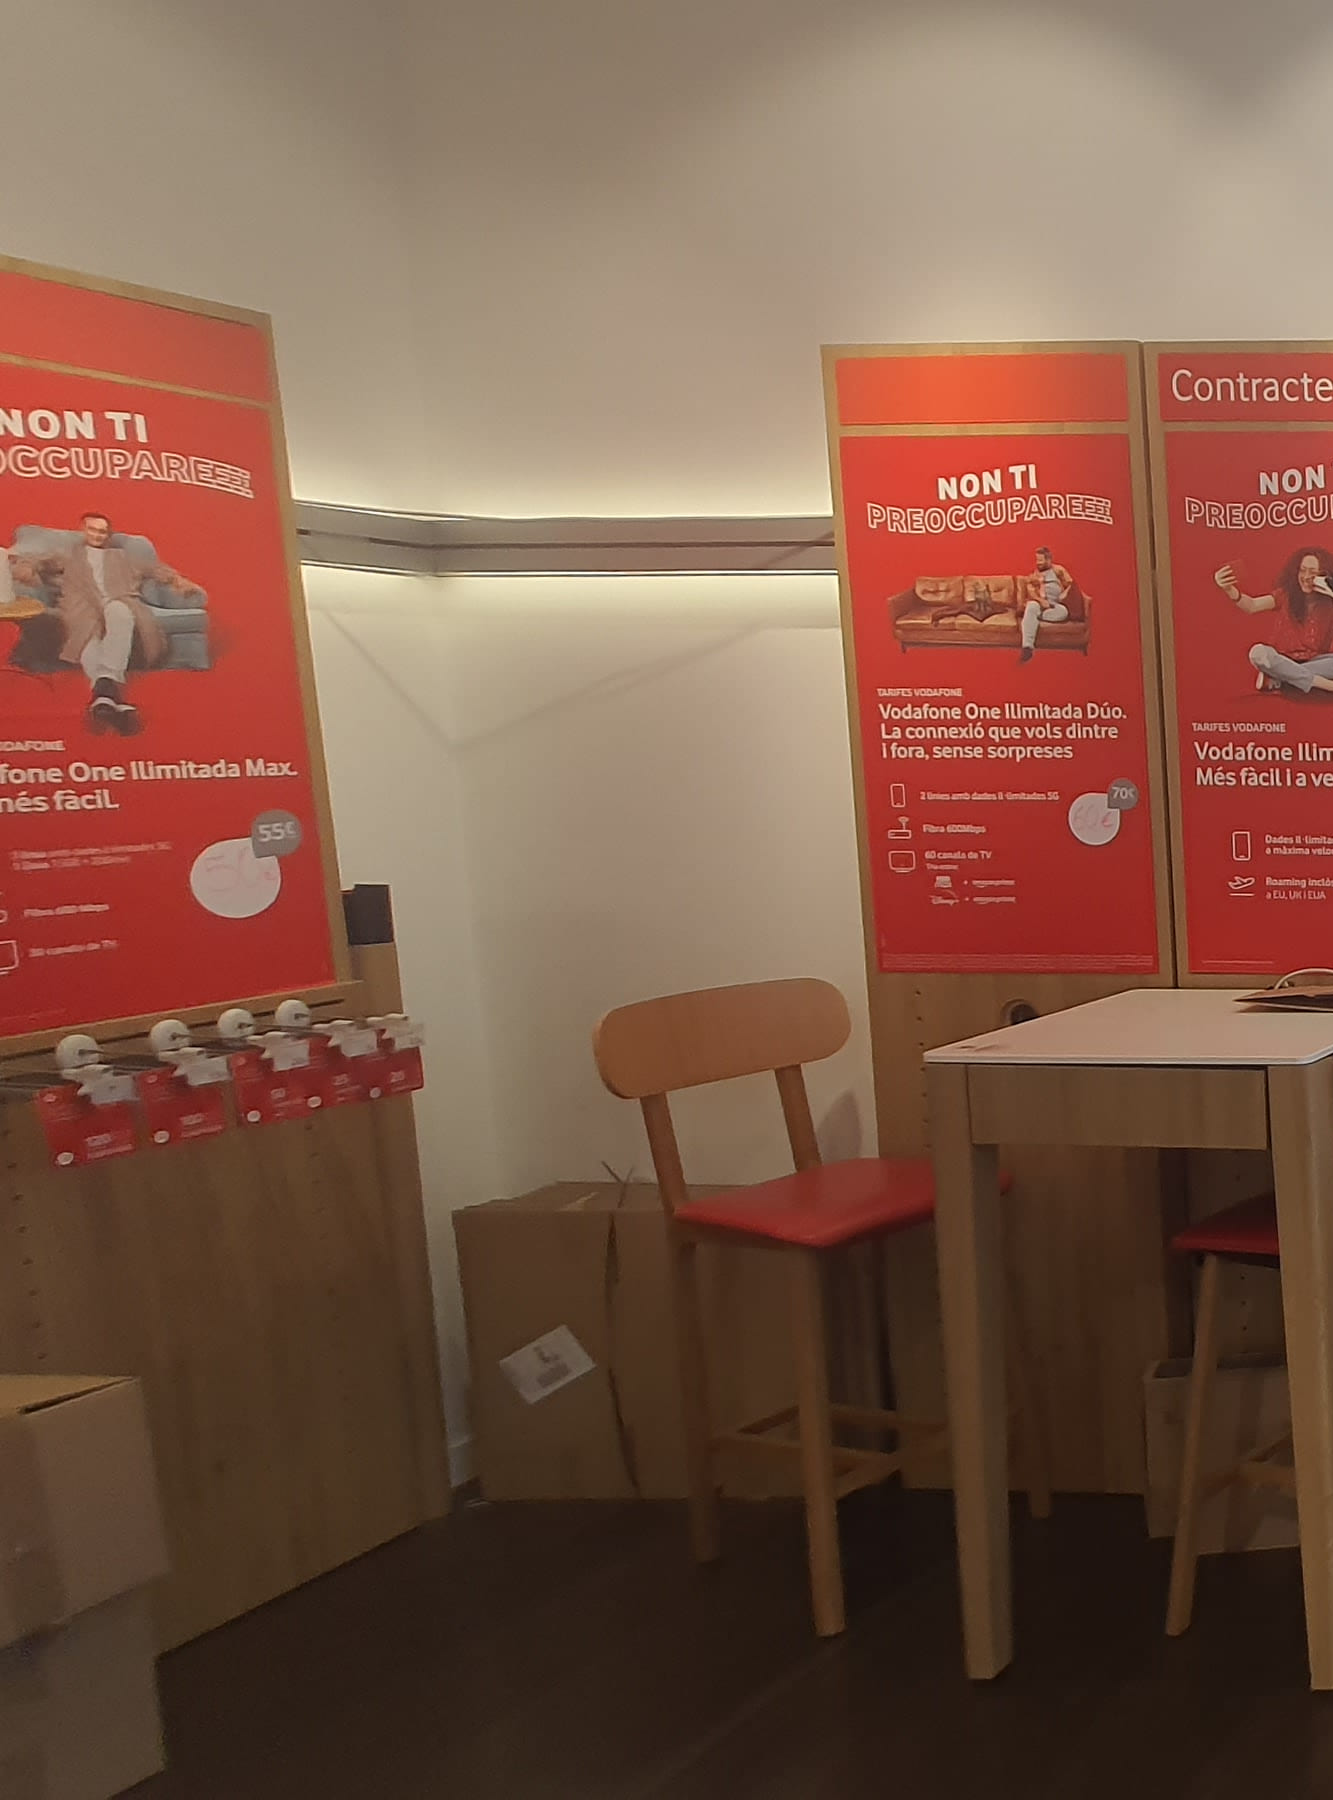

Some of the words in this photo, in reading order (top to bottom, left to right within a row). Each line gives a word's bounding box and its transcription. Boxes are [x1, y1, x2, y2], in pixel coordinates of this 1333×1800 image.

[1171, 368, 1333, 403] Contracte
[105, 411, 149, 443] TI
[937, 467, 1003, 501] NON
[1008, 463, 1037, 490] TI
[1259, 463, 1326, 496] NON
[877, 687, 913, 698] TARIFES
[914, 688, 963, 698] VODAFONE
[878, 702, 962, 720] Vodafone
[965, 703, 1001, 720] One
[1005, 702, 1083, 720] Ilimitada
[1087, 701, 1128, 720] Dúo.
[881, 723, 902, 740] La
[905, 722, 985, 740] connexió
[988, 726, 1022, 743] que
[1024, 722, 1062, 740] vols
[1065, 722, 1119, 740] dintre
[1192, 722, 1231, 733] TARIFES
[1232, 723, 1287, 733] VODAFONE
[890, 742, 930, 761] fora,
[932, 746, 984, 760] sense
[987, 746, 1074, 762] sorpreses
[1194, 741, 1293, 762] Vodafone
[68, 761, 127, 783] One
[130, 758, 241, 781] Ilimitada
[245, 758, 299, 778] Max.
[1195, 766, 1237, 786] Més
[1239, 766, 1282, 787] fàcil
[1286, 769, 1291, 787] i
[1295, 773, 1307, 788] a
[1265, 834, 1294, 844] Dades
[979, 850, 992, 860] TV
[1272, 845, 1310, 856] màxima
[1265, 876, 1307, 888] Roaming
[1288, 890, 1302, 900] UK
